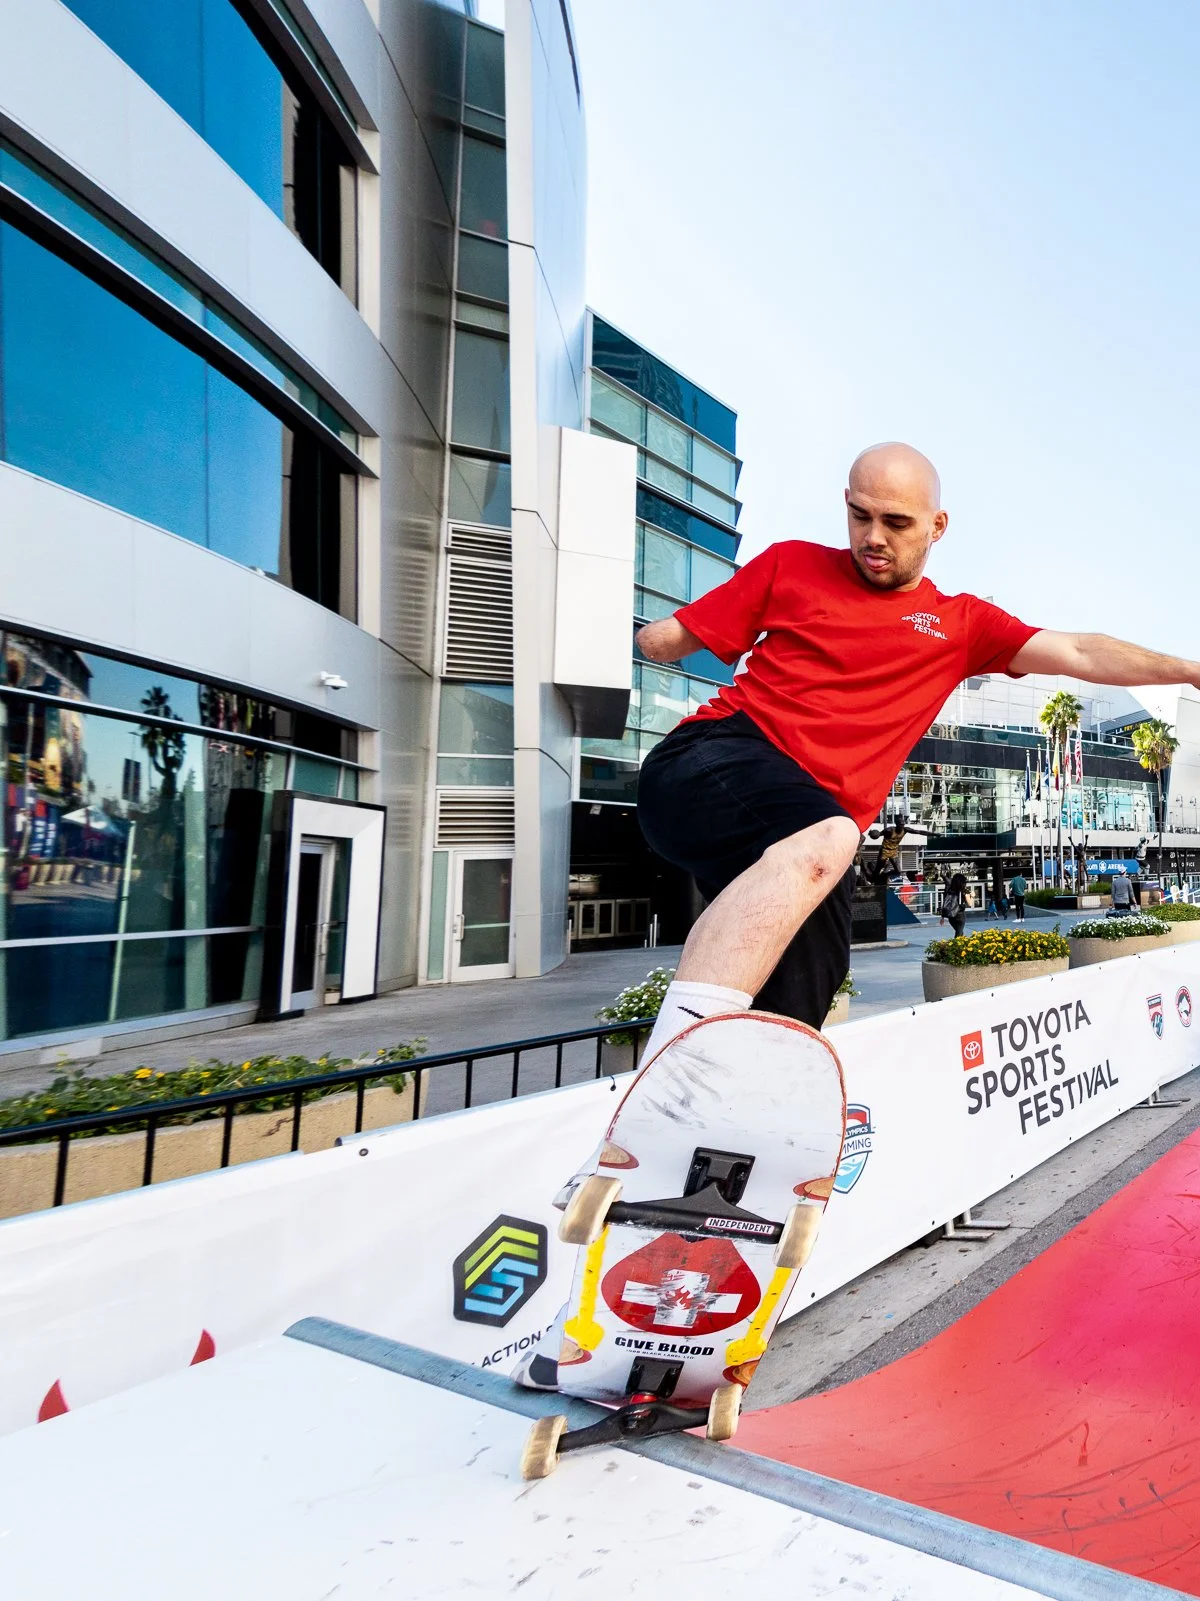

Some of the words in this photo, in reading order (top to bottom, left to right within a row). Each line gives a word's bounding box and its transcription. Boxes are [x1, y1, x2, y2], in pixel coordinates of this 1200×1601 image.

[914, 623, 948, 640] FESTIVAL
[991, 1000, 1091, 1057] TOYOTA
[966, 1044, 1065, 1115] SPORTS
[1018, 1059, 1119, 1135] FESTIVAL
[709, 1218, 772, 1233] INDEPENDENT
[481, 1330, 541, 1368] ACTION
[614, 1336, 655, 1351] GIVE
[657, 1342, 715, 1356] BLOOD
